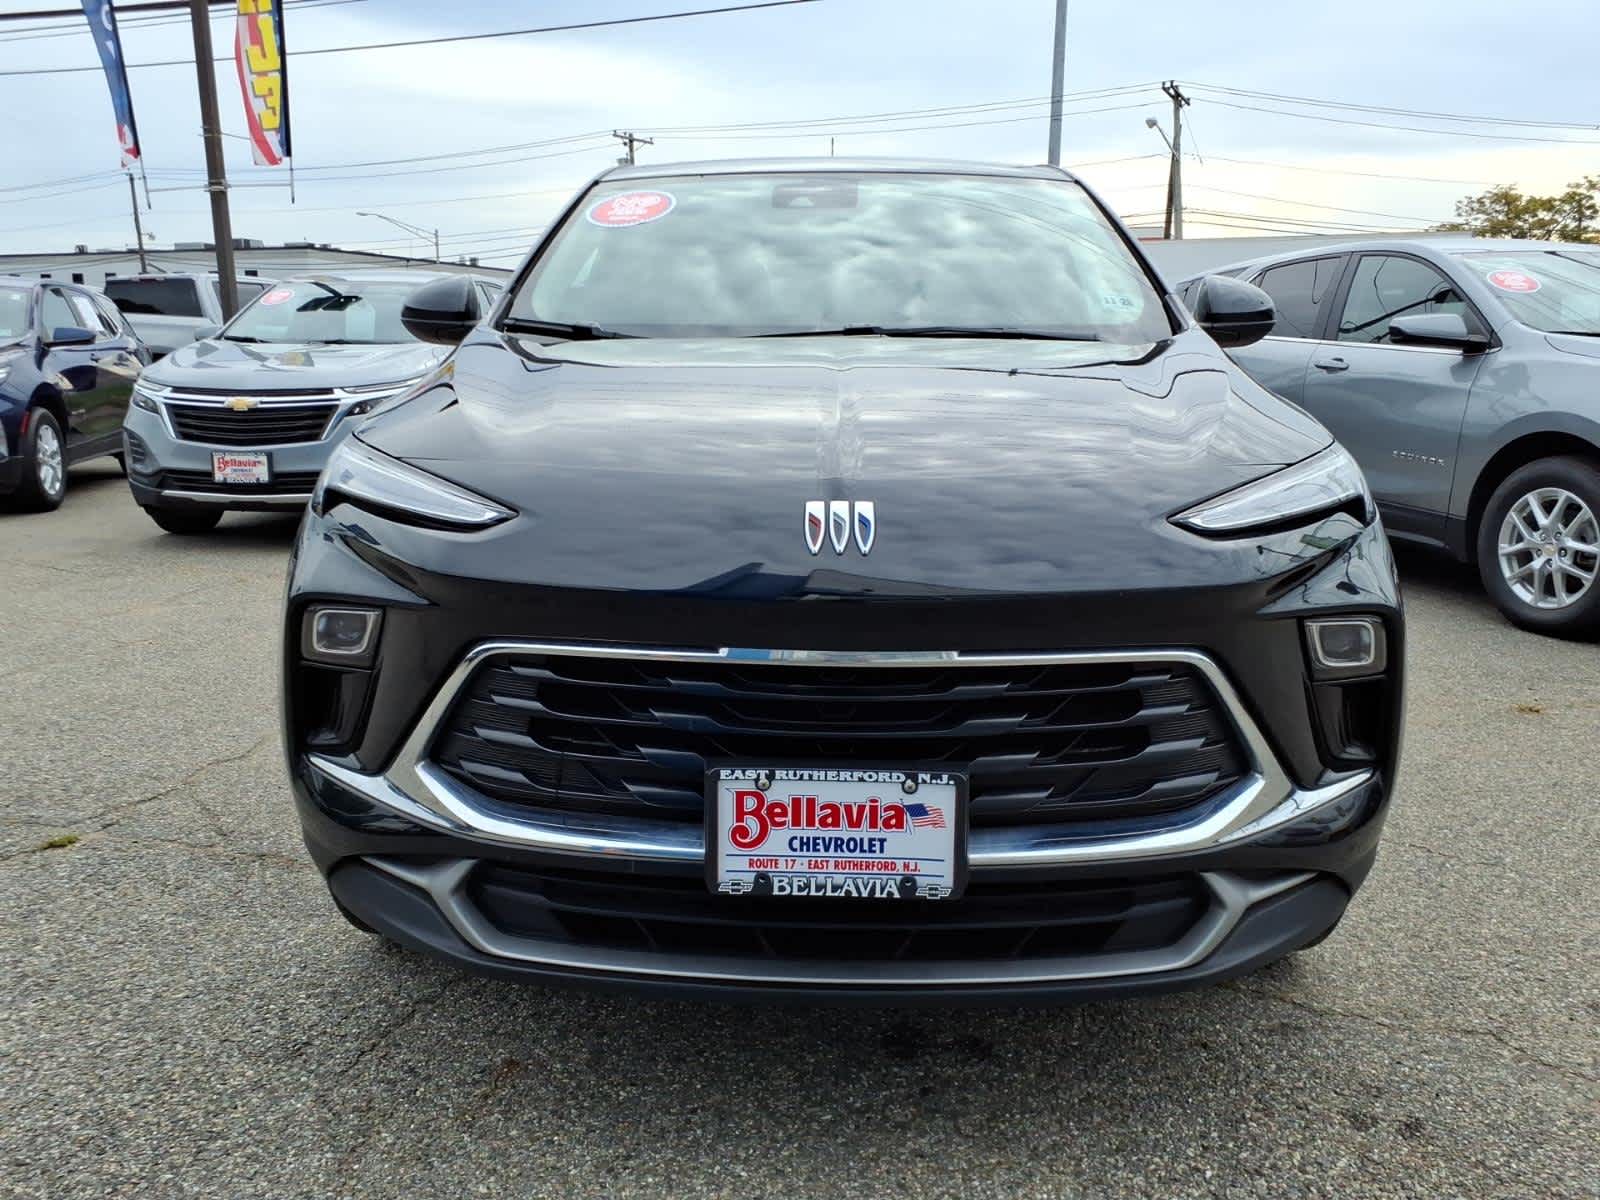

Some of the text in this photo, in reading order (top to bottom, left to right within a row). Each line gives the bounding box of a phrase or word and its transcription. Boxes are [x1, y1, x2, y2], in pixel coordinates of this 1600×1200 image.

[719, 769, 769, 780] EAST
[918, 773, 955, 785] N.J.
[728, 787, 909, 850] Bellavia
[788, 836, 887, 855] CHEVROLET
[748, 858, 921, 873] ROUTE 17 EAST RUTHERFORD, N.J.
[771, 876, 901, 898] BELLAVIA
